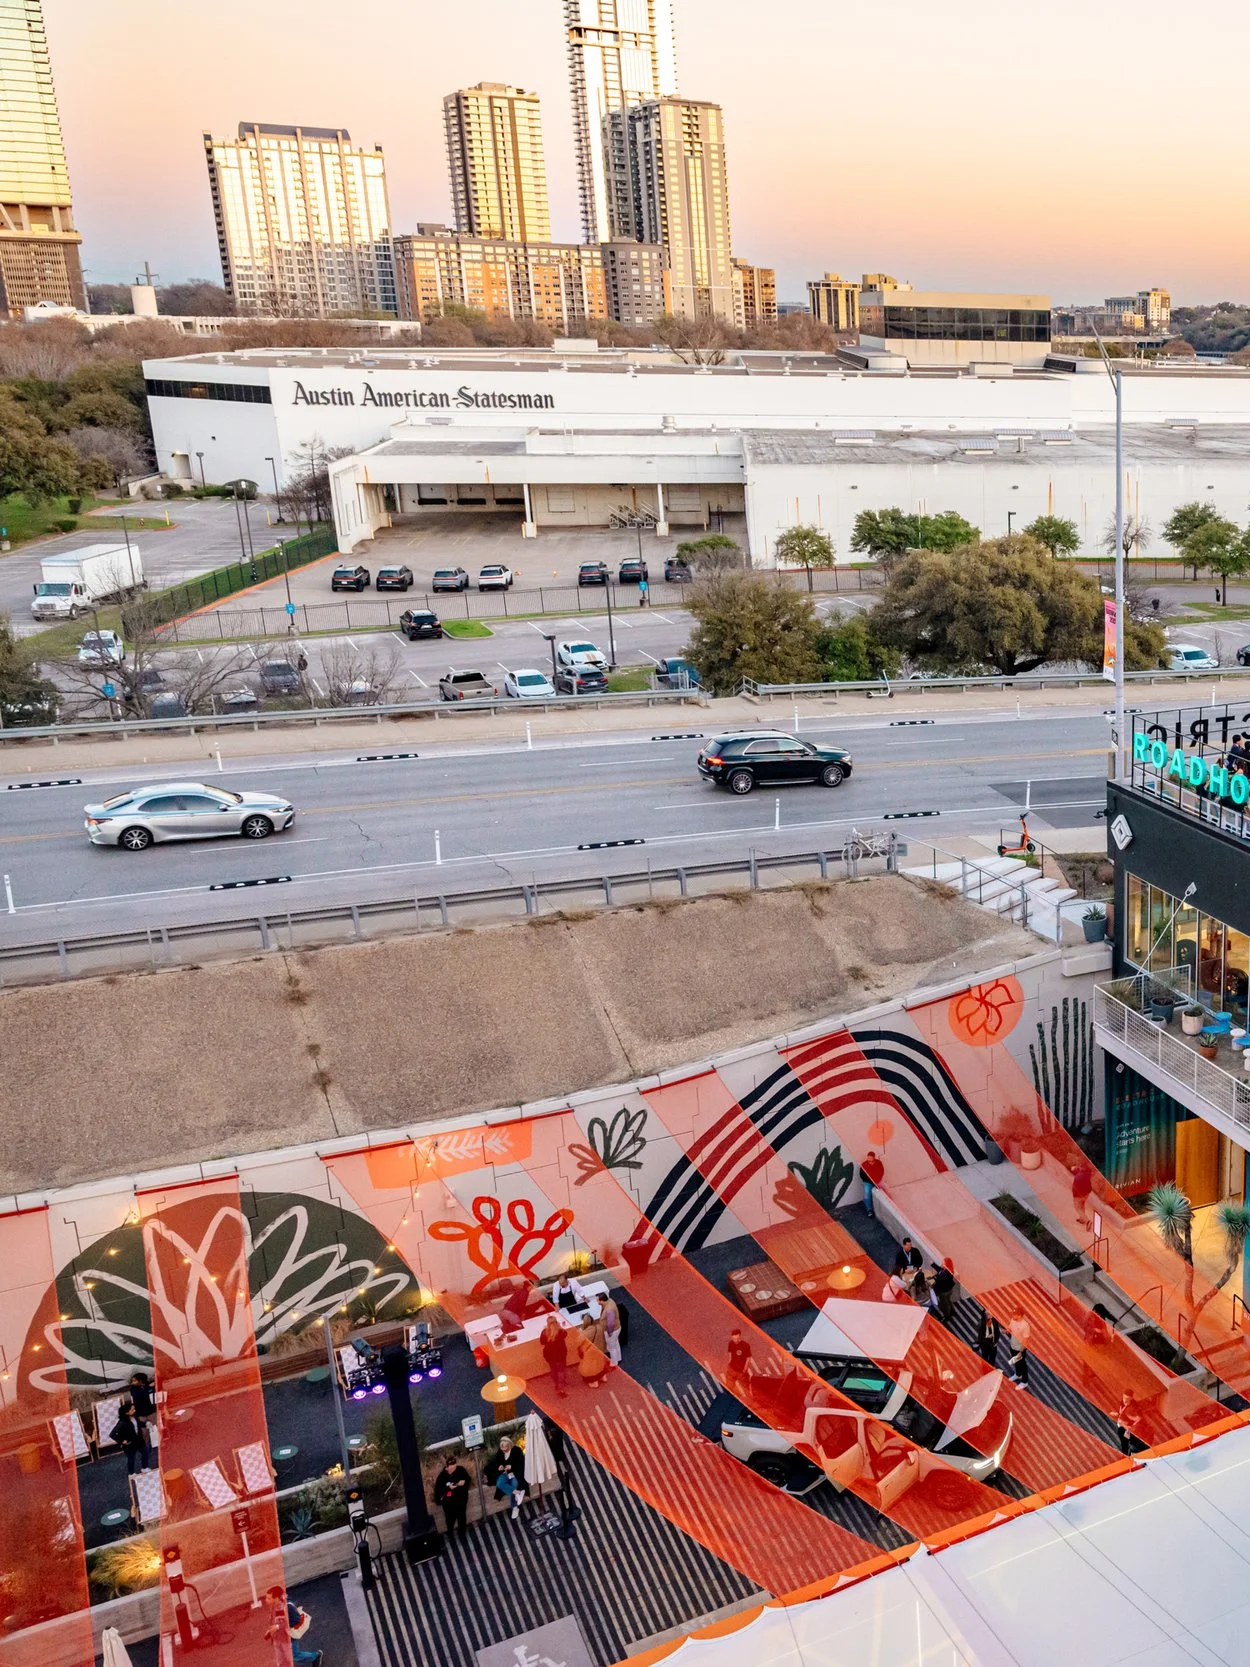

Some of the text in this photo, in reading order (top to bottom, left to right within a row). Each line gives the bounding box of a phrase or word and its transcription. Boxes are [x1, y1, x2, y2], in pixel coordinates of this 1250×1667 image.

[292, 381, 555, 409] Austin American-Statesman
[1115, 1178, 1141, 1190] RIVIAN
